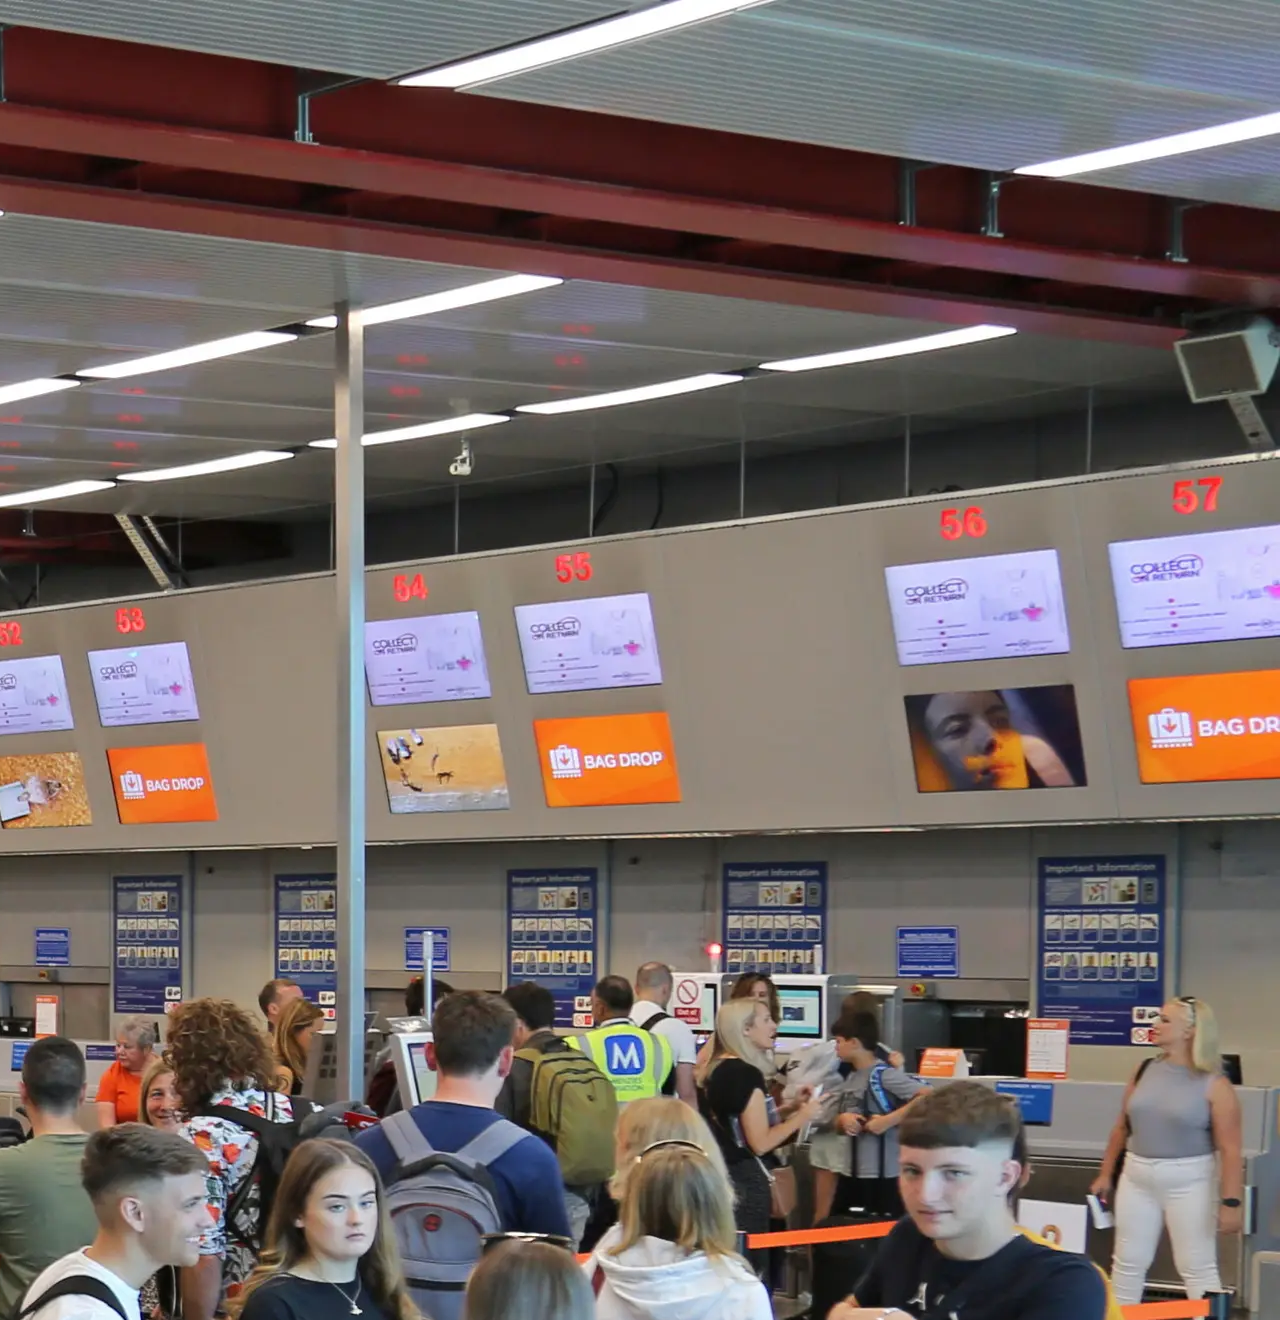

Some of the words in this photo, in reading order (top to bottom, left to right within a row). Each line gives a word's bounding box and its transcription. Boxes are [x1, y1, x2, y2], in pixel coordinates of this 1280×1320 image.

[1172, 477, 1222, 514] 57
[940, 507, 988, 540] 56
[555, 552, 593, 583] 55
[1130, 556, 1203, 577] COLLECT
[393, 574, 428, 601] 54
[904, 580, 967, 600] COLLECT
[115, 608, 146, 634] 53
[530, 617, 580, 635] COLLECT
[373, 634, 417, 649] COLLECT
[1198, 719, 1244, 737] BAG
[584, 754, 617, 768] BAG
[620, 751, 663, 767] DROP
[146, 780, 170, 792] BAG
[172, 777, 204, 790] DROP
[728, 870, 769, 878] Important
[771, 868, 819, 877] Information
[1045, 864, 1094, 874] Important
[1096, 863, 1157, 873] Information
[511, 876, 547, 884] Important
[612, 1042, 640, 1070] M
